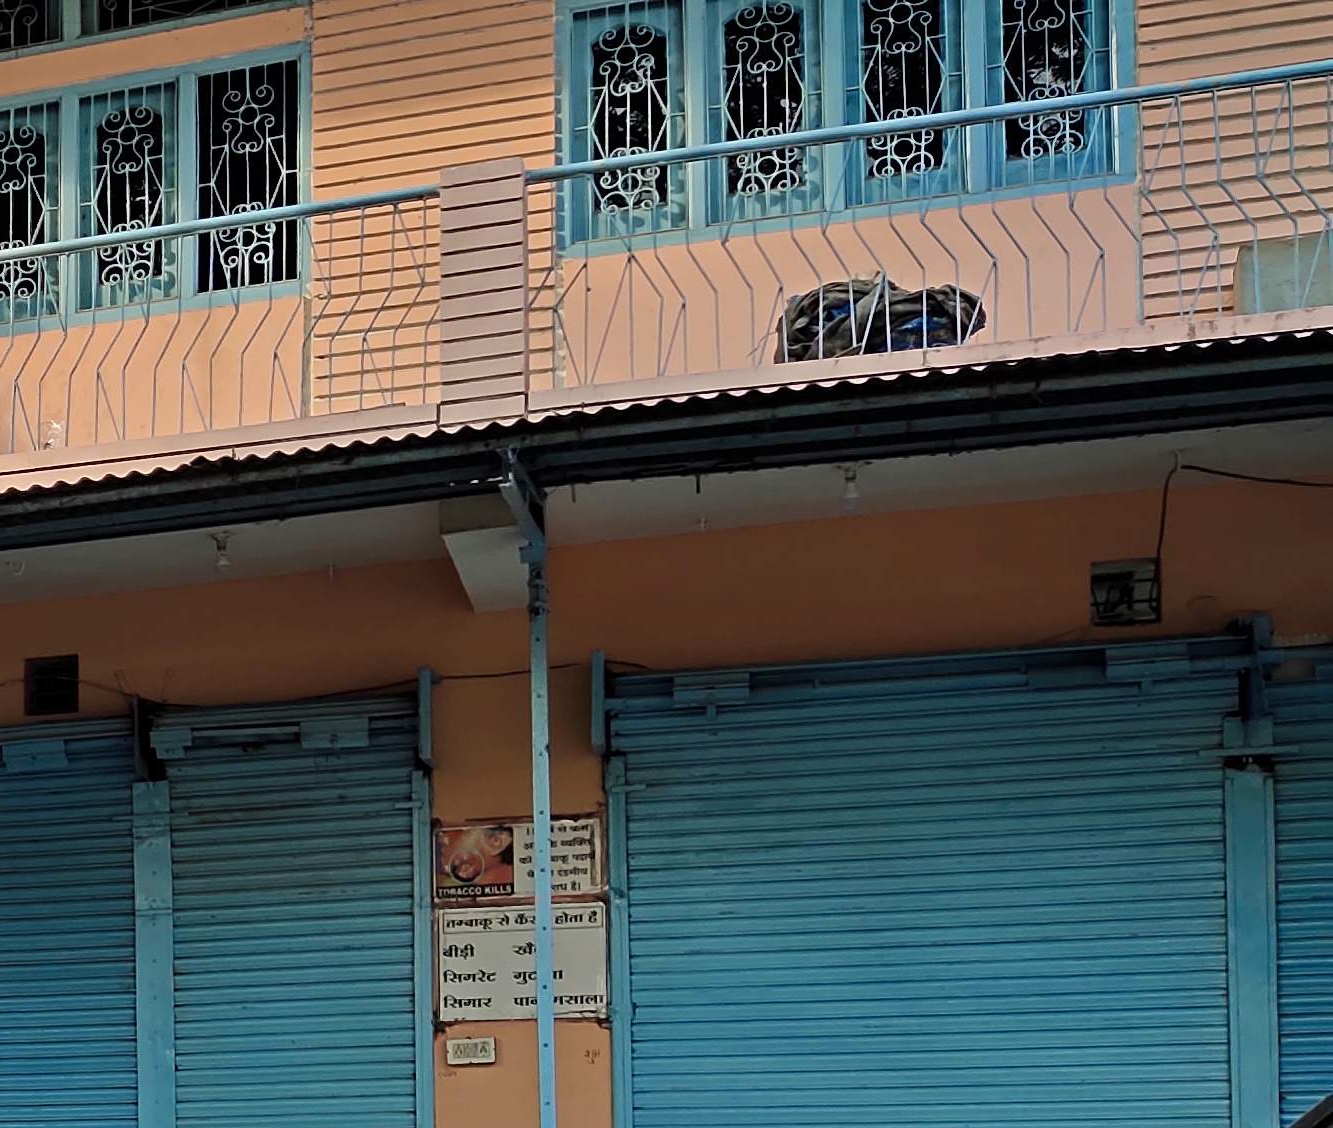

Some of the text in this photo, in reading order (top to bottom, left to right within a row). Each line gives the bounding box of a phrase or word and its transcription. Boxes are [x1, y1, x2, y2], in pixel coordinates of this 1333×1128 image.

[438, 884, 512, 896] TOBACCO KILLS
[555, 911, 583, 924] होता
[443, 969, 497, 983] सिगरेट
[443, 995, 492, 1009] सिगार
